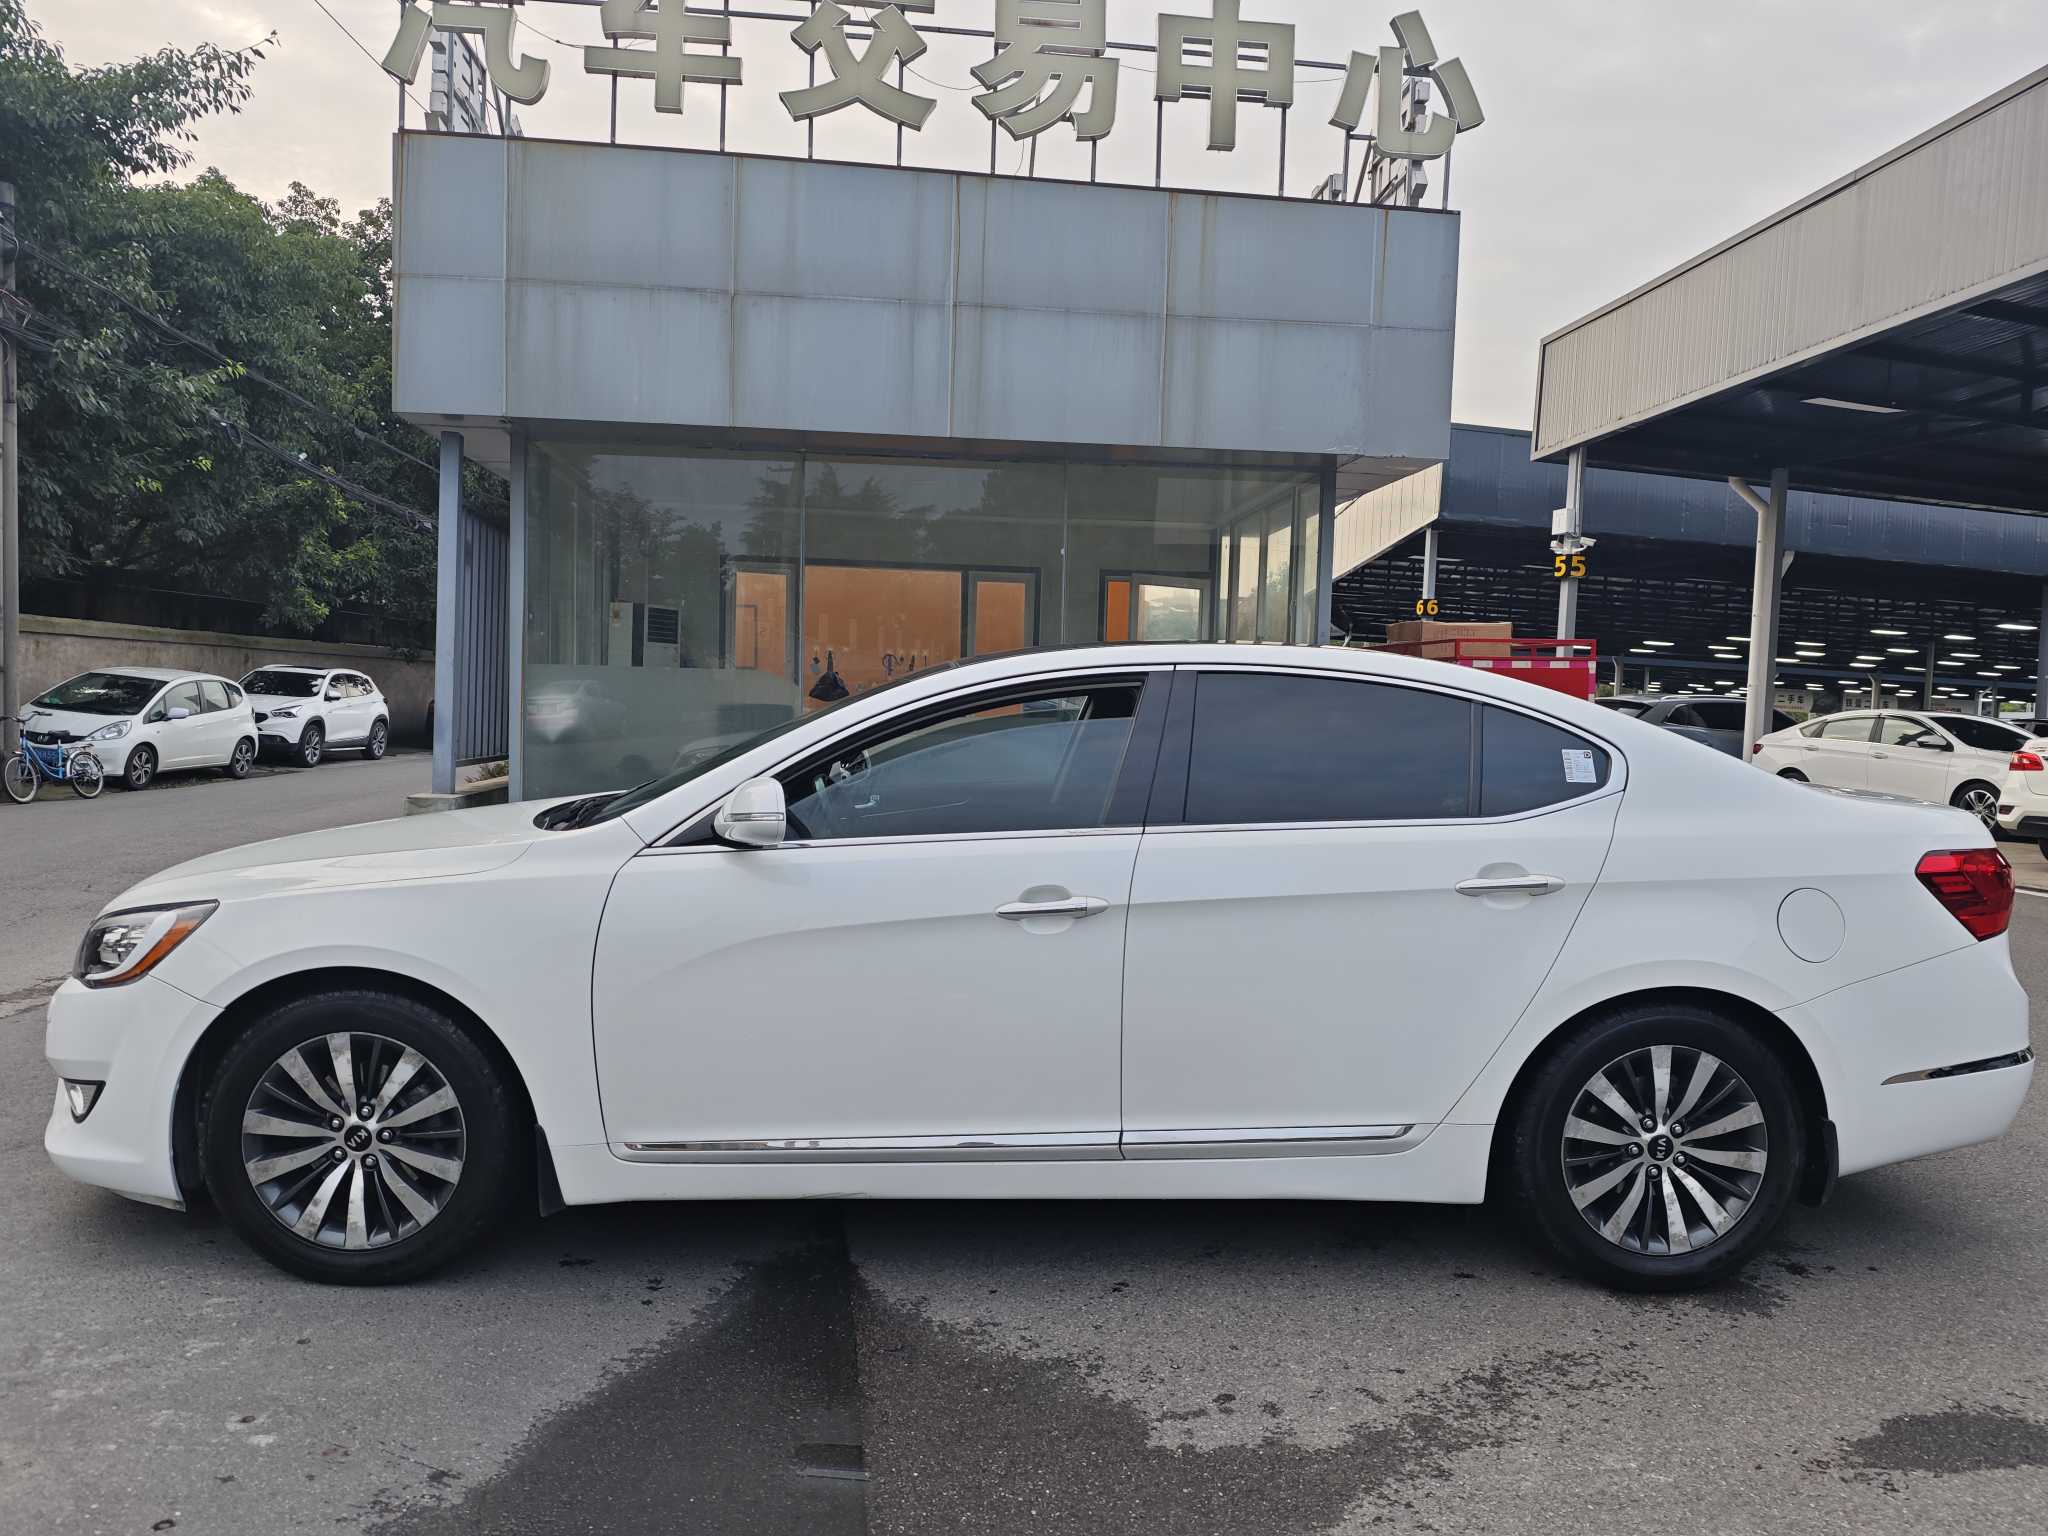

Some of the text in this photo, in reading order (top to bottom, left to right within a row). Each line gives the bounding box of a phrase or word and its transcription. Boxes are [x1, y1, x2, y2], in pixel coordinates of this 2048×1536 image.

[1554, 555, 1585, 577] 55
[1416, 600, 1439, 615] 66
[347, 1129, 368, 1147] KIA
[1655, 1138, 1666, 1158] KIA
